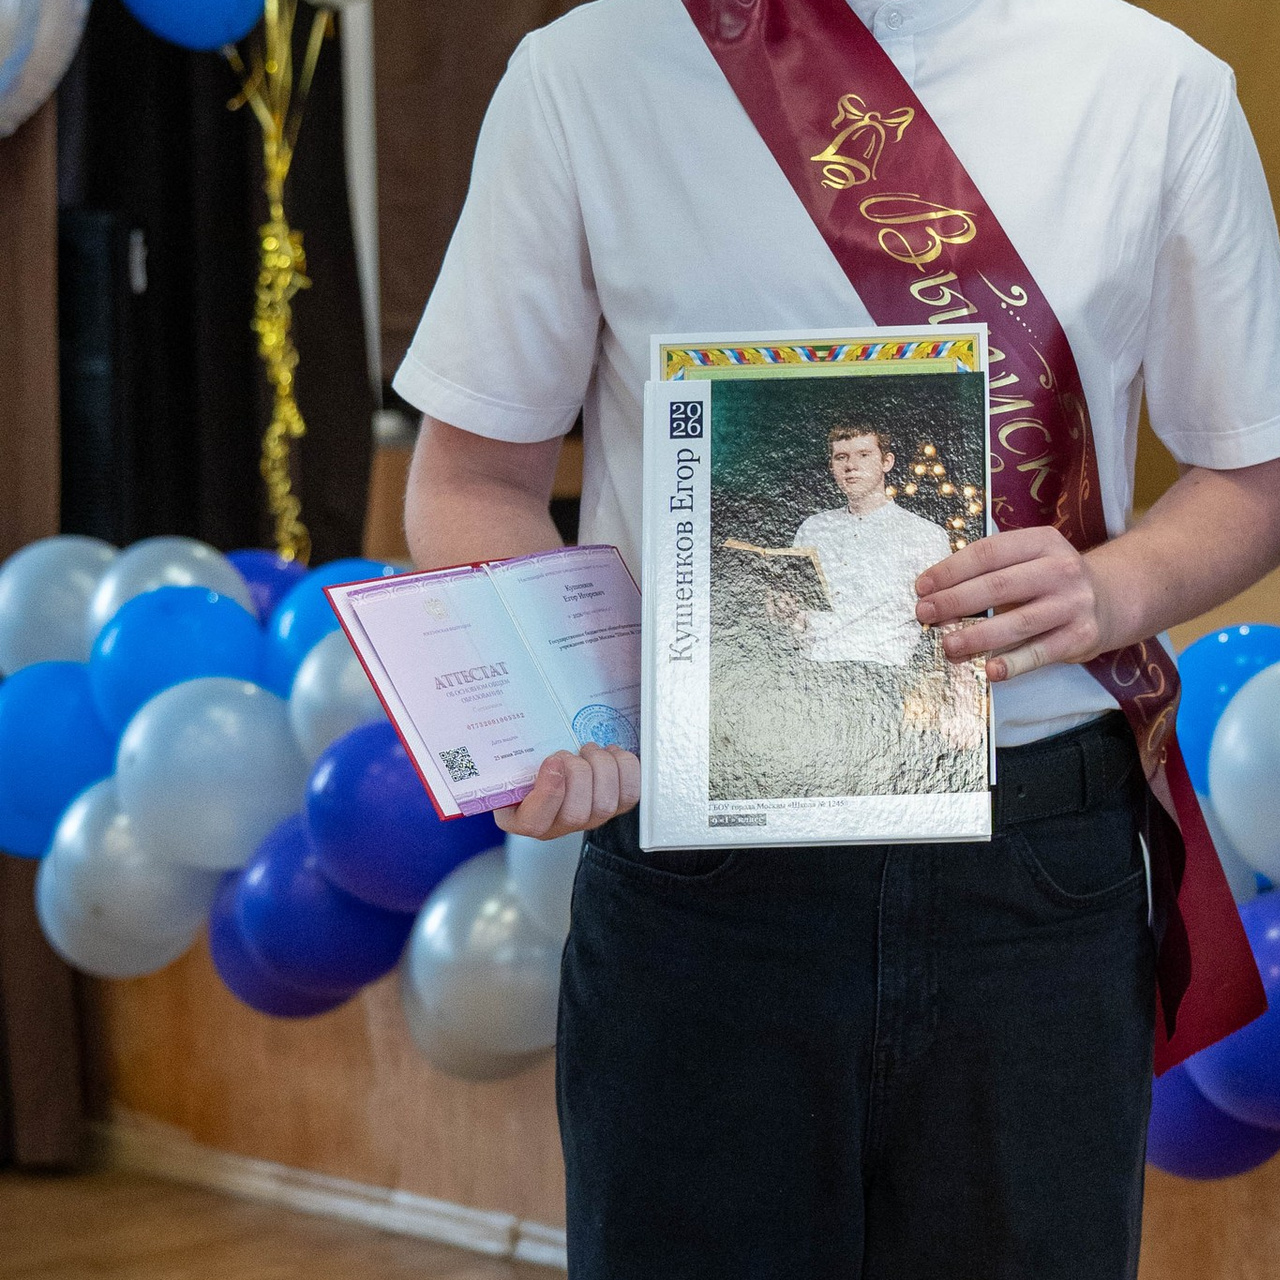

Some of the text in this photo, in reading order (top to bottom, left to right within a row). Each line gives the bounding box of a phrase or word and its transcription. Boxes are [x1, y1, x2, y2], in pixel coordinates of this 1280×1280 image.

[669, 447, 700, 663] Кушенков Егор
[434, 661, 509, 690] АТТЕСТАТ
